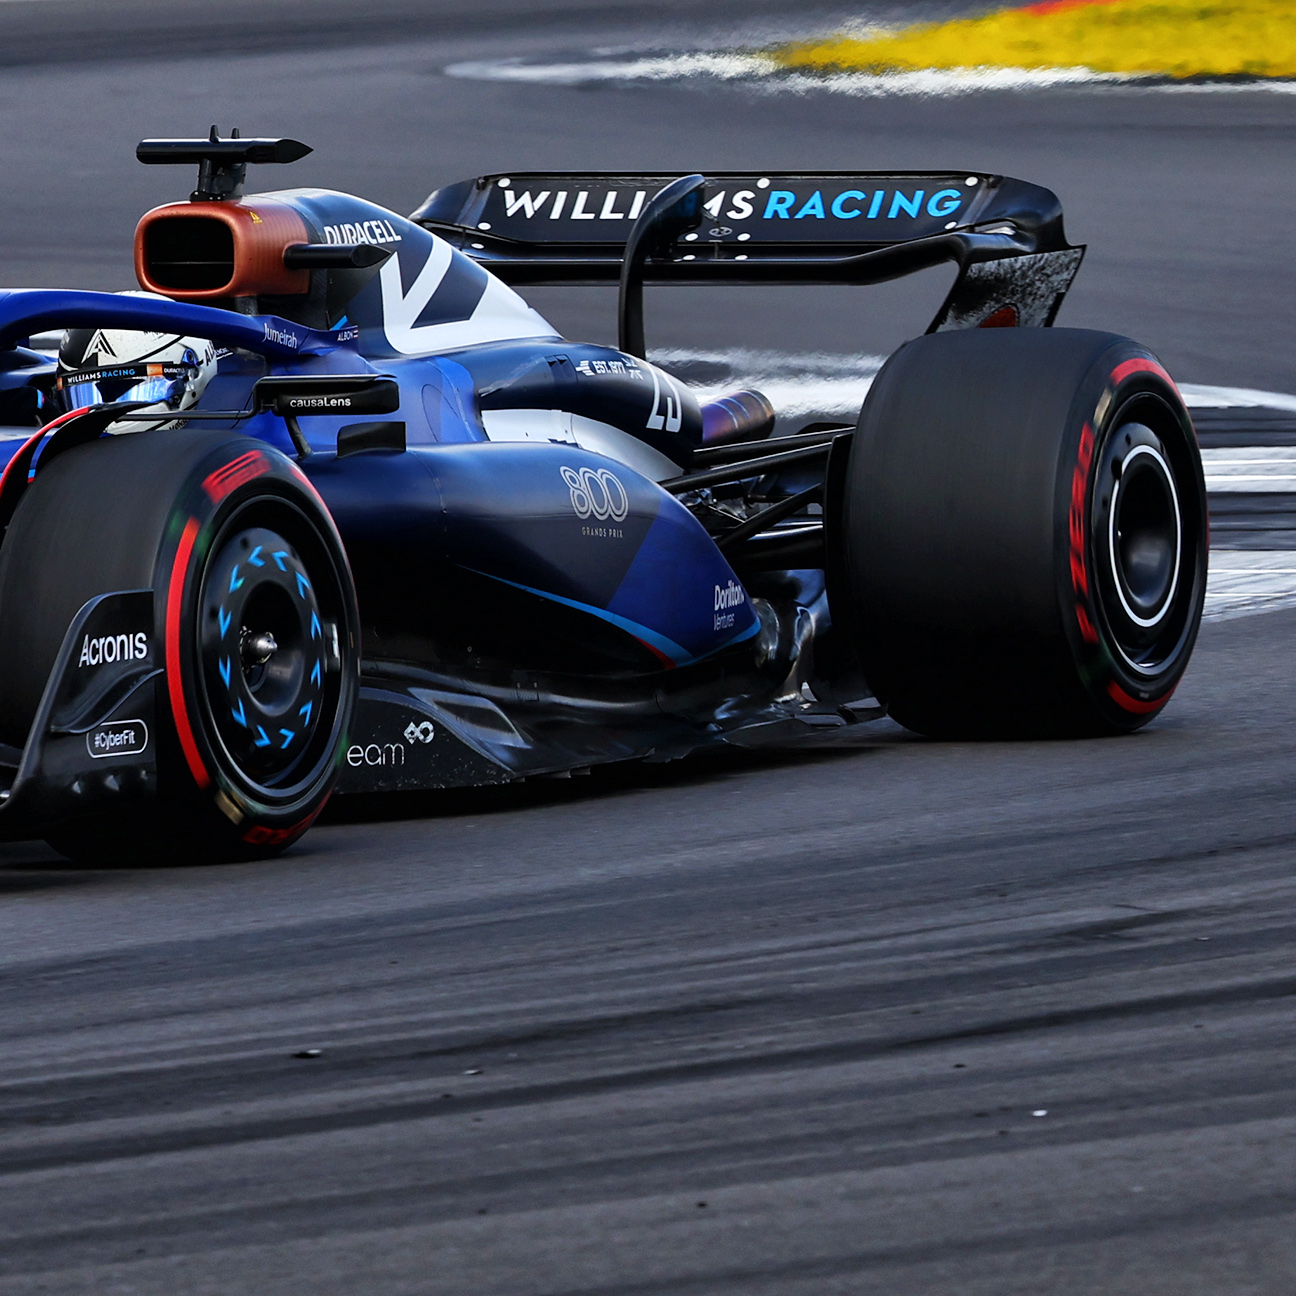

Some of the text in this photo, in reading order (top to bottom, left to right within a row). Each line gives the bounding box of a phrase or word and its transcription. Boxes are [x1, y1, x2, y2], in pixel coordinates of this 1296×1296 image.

[504, 190, 962, 220] WILLIMS RACING
[323, 219, 402, 245] DURACELL
[262, 323, 298, 349] Jumeirah
[337, 330, 353, 342] ALBON
[67, 368, 136, 384] WILLIAMS RACING
[289, 397, 352, 408] causaLens
[559, 465, 629, 522] 800
[581, 526, 623, 538] GRANDS PRIX
[79, 631, 149, 667] Acronis
[94, 727, 136, 749] #CyberFit
